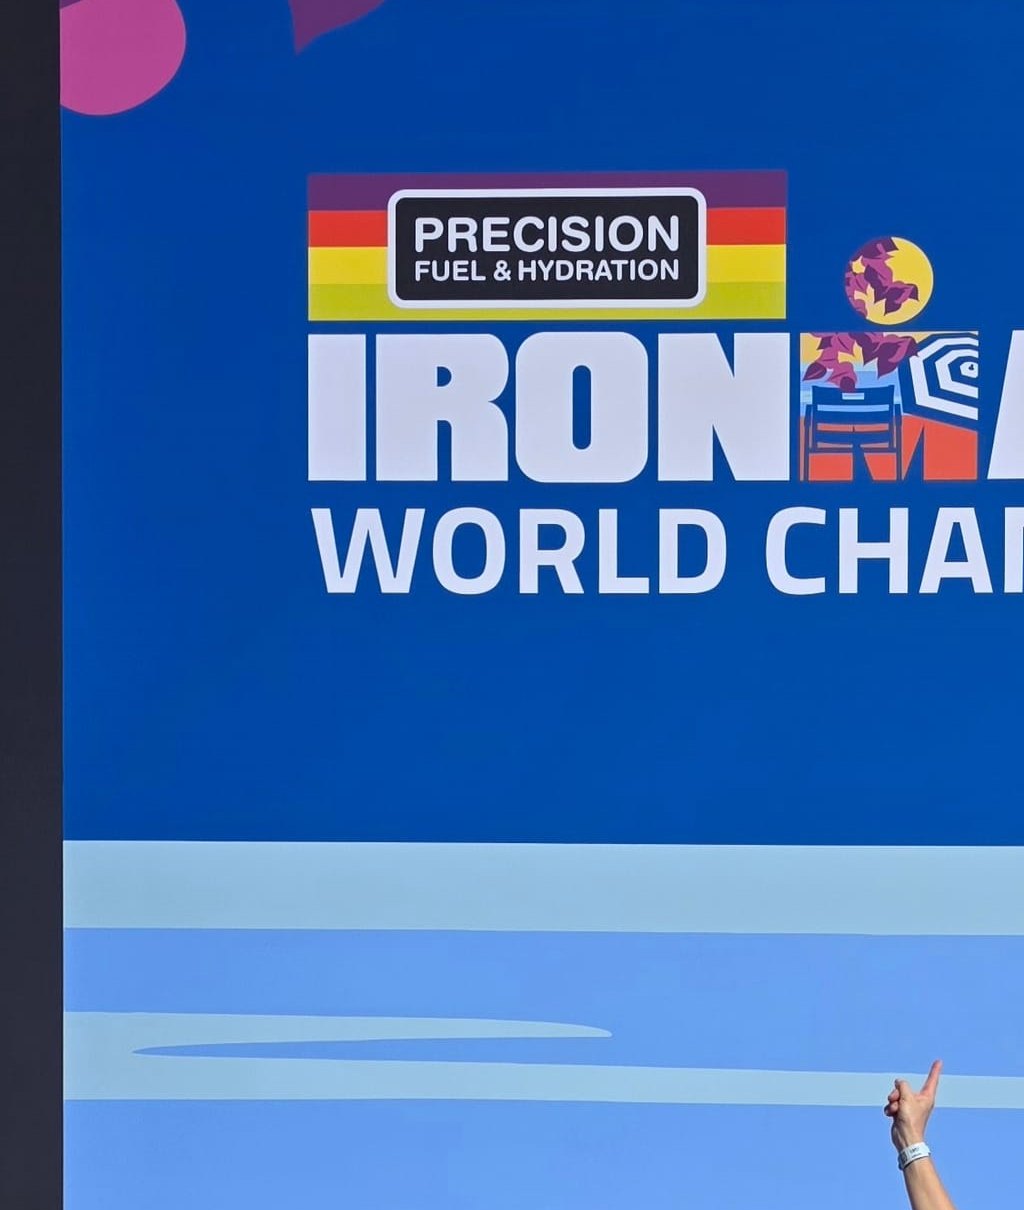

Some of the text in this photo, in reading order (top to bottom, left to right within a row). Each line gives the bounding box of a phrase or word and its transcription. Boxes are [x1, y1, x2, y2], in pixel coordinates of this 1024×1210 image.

[415, 215, 679, 253] PRECISION
[415, 258, 679, 282] FUEL & HYDRATION
[311, 507, 727, 595] WORLD
